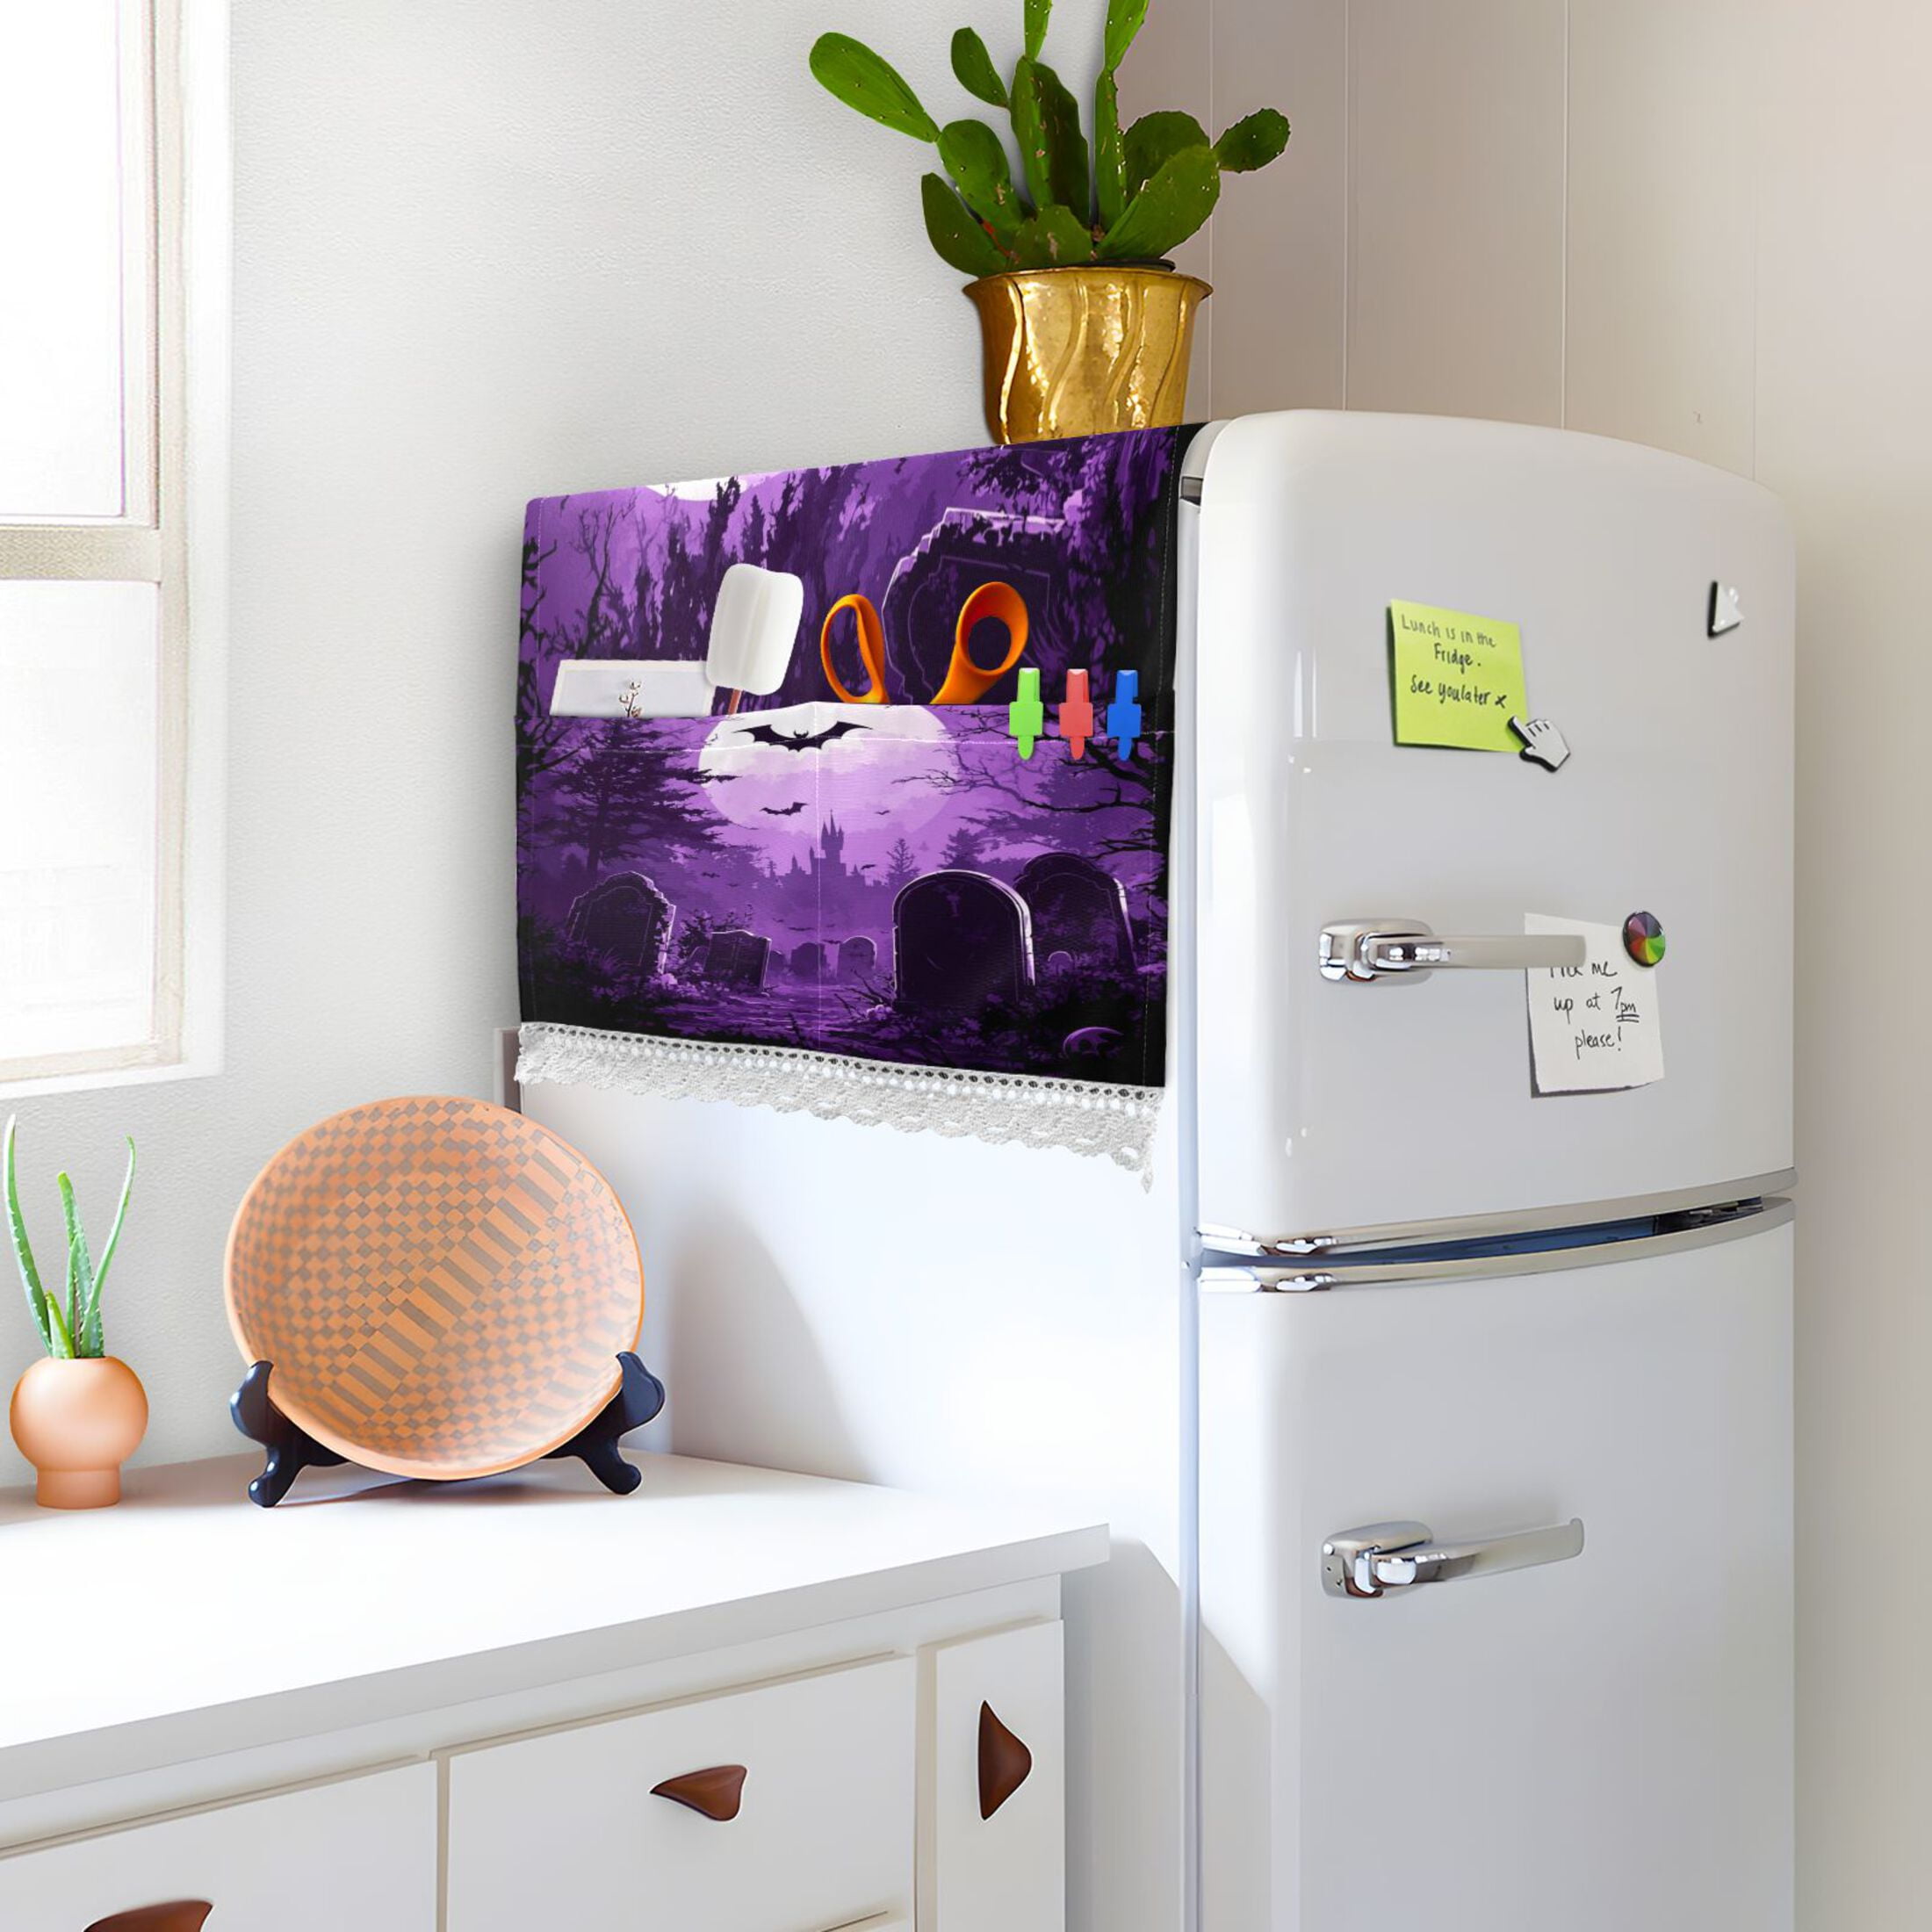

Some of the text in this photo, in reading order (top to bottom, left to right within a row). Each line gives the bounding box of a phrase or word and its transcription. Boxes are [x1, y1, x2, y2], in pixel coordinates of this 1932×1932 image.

[1401, 613, 1441, 638] Lunch
[1461, 631, 1474, 643] in
[1477, 631, 1496, 648] the
[1410, 674, 1433, 695] See
[1554, 996, 1574, 1024] up
[1586, 992, 1601, 1010] at
[1575, 1026, 1621, 1060] please!
